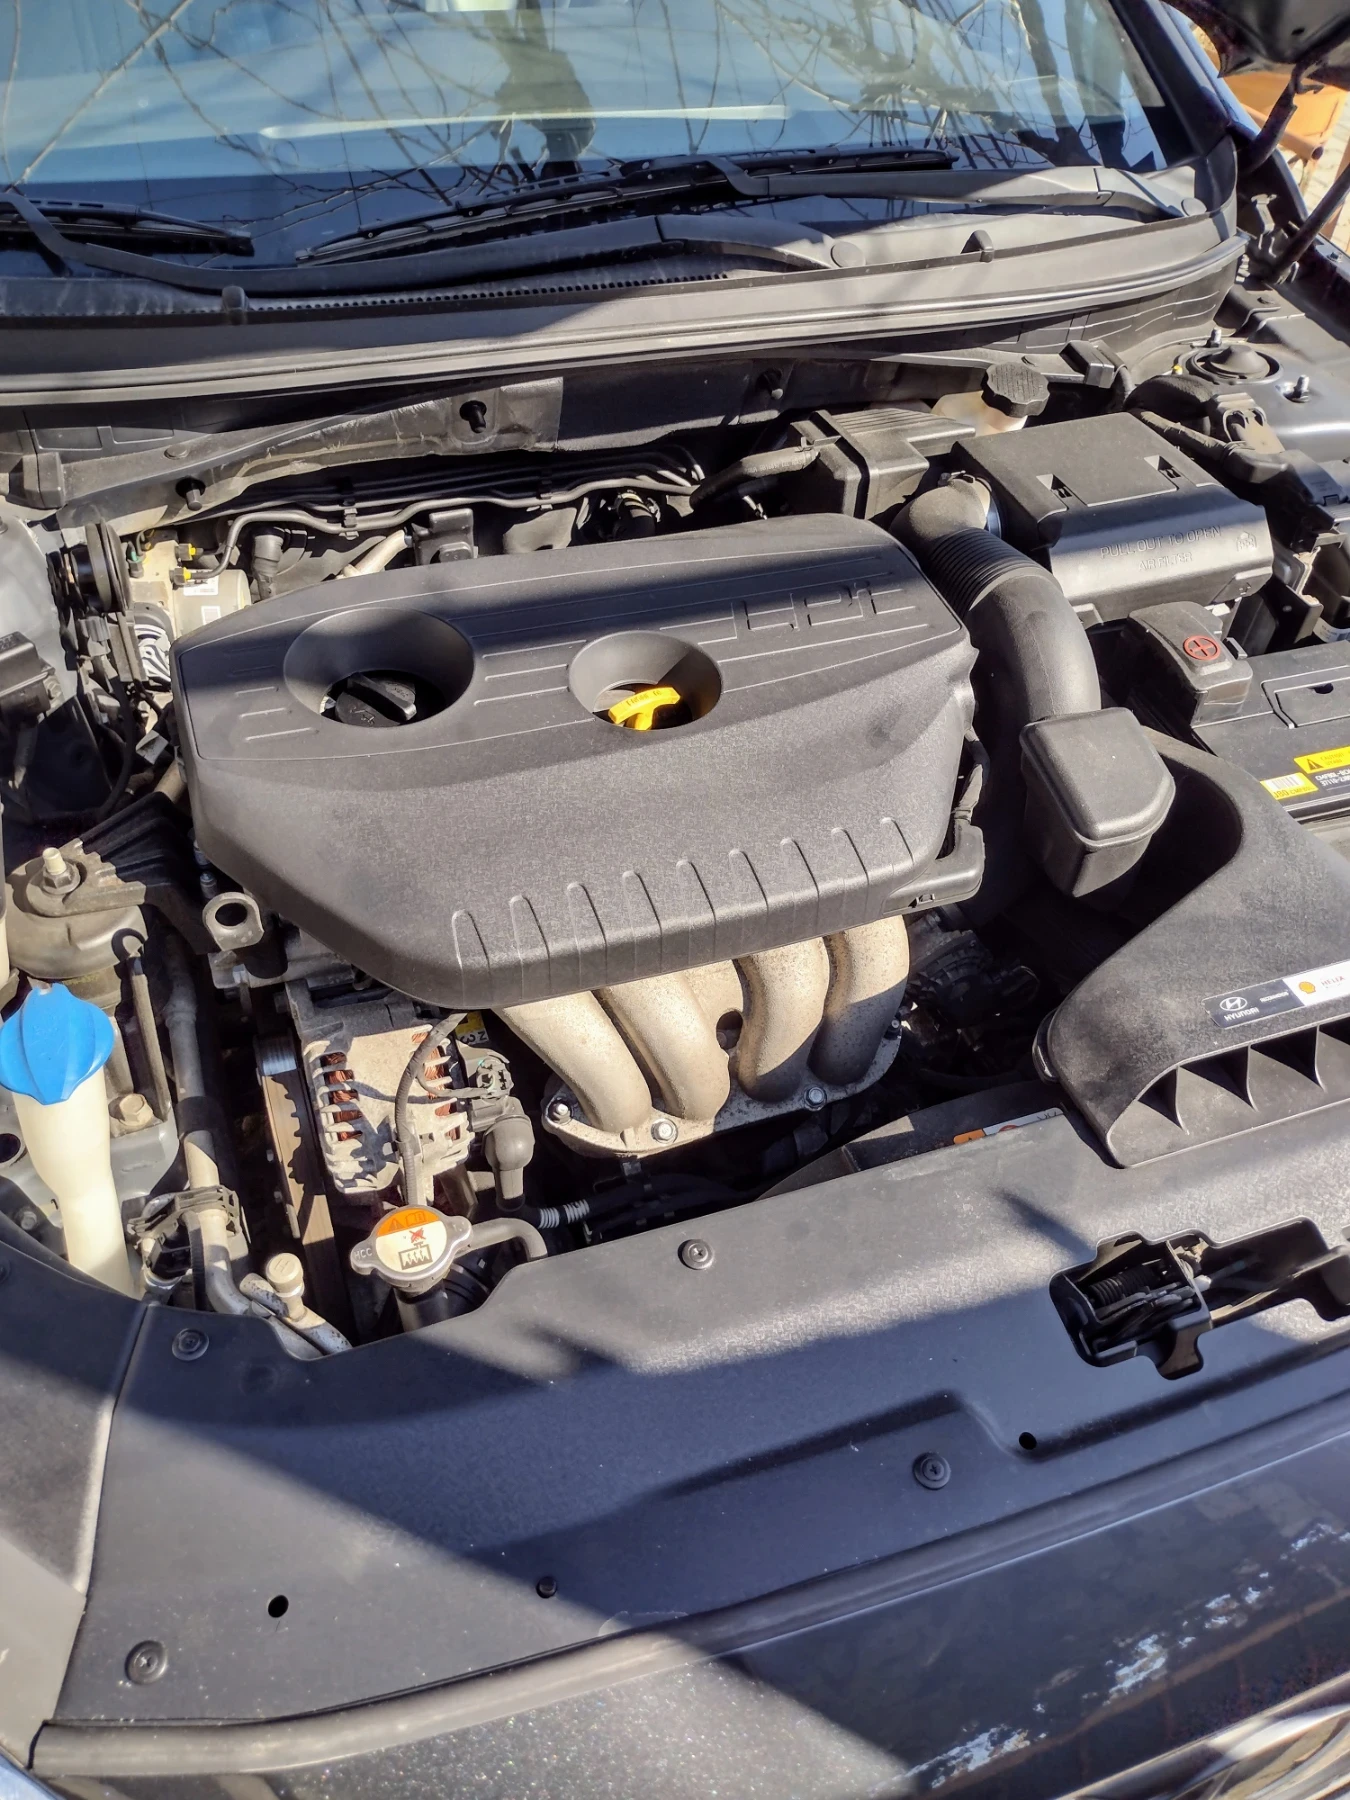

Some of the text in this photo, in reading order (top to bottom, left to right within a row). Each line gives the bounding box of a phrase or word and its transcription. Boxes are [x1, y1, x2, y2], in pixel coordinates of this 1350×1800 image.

[1100, 543, 1136, 559] PULL
[1137, 535, 1164, 552] OUT
[1168, 531, 1186, 546] TO
[1187, 525, 1222, 543] OPEN
[1138, 552, 1193, 572] AIR FILTER
[1224, 1007, 1259, 1021] HYUNDAI
[353, 1247, 373, 1259] HCC
